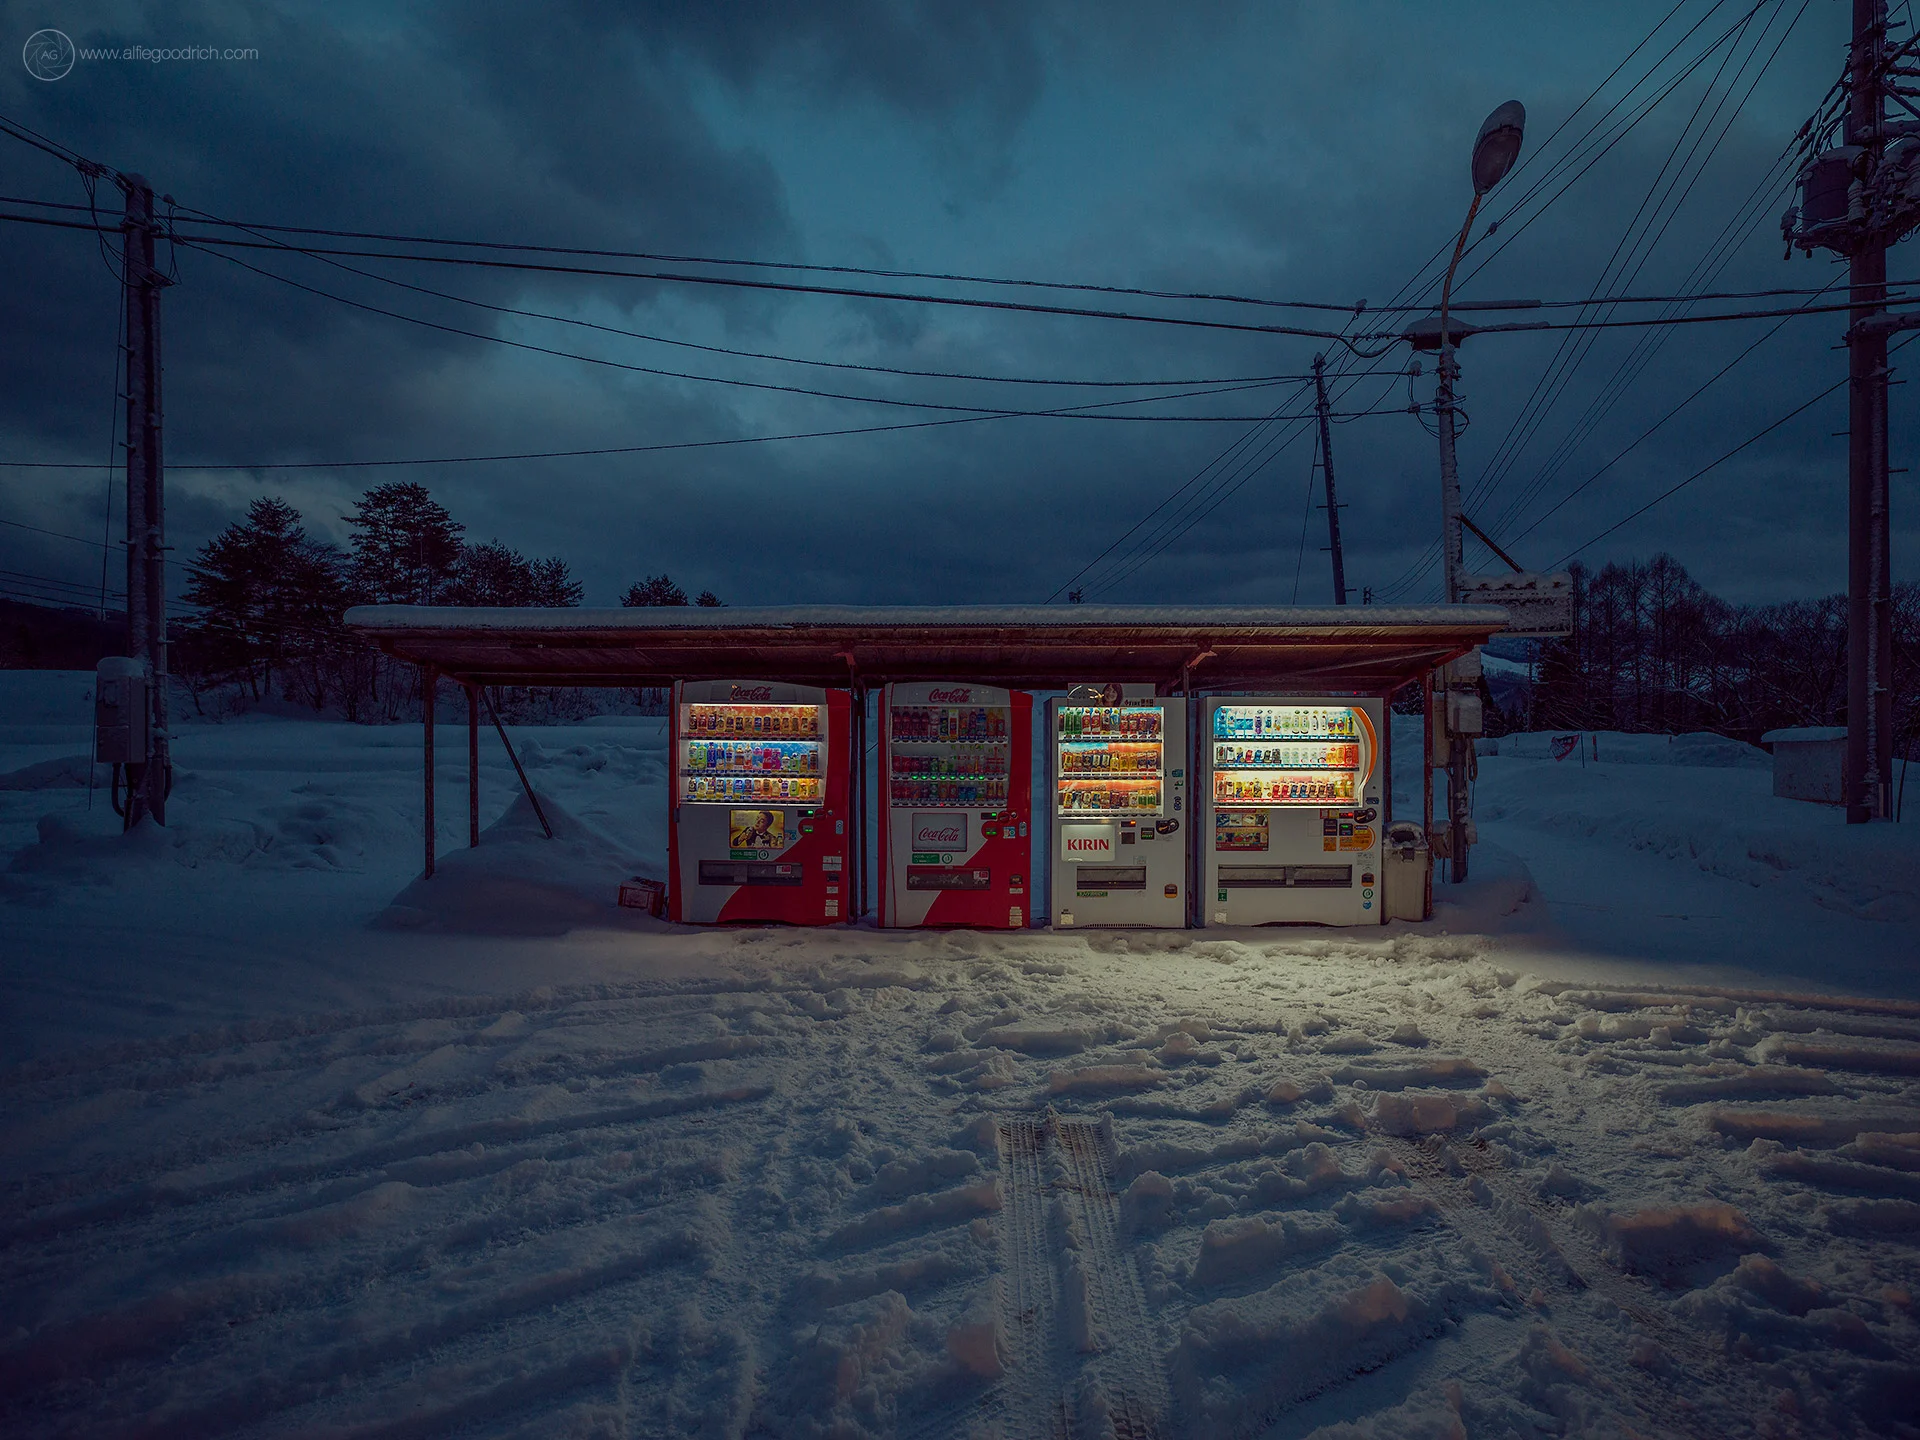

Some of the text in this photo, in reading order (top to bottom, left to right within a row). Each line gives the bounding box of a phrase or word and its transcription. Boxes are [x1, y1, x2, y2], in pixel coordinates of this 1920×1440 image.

[730, 685, 773, 700] Coca-Cola
[928, 688, 971, 703] Coca-Cola
[918, 827, 960, 842] Coca-Cola
[1067, 839, 1109, 851] KIRIN
